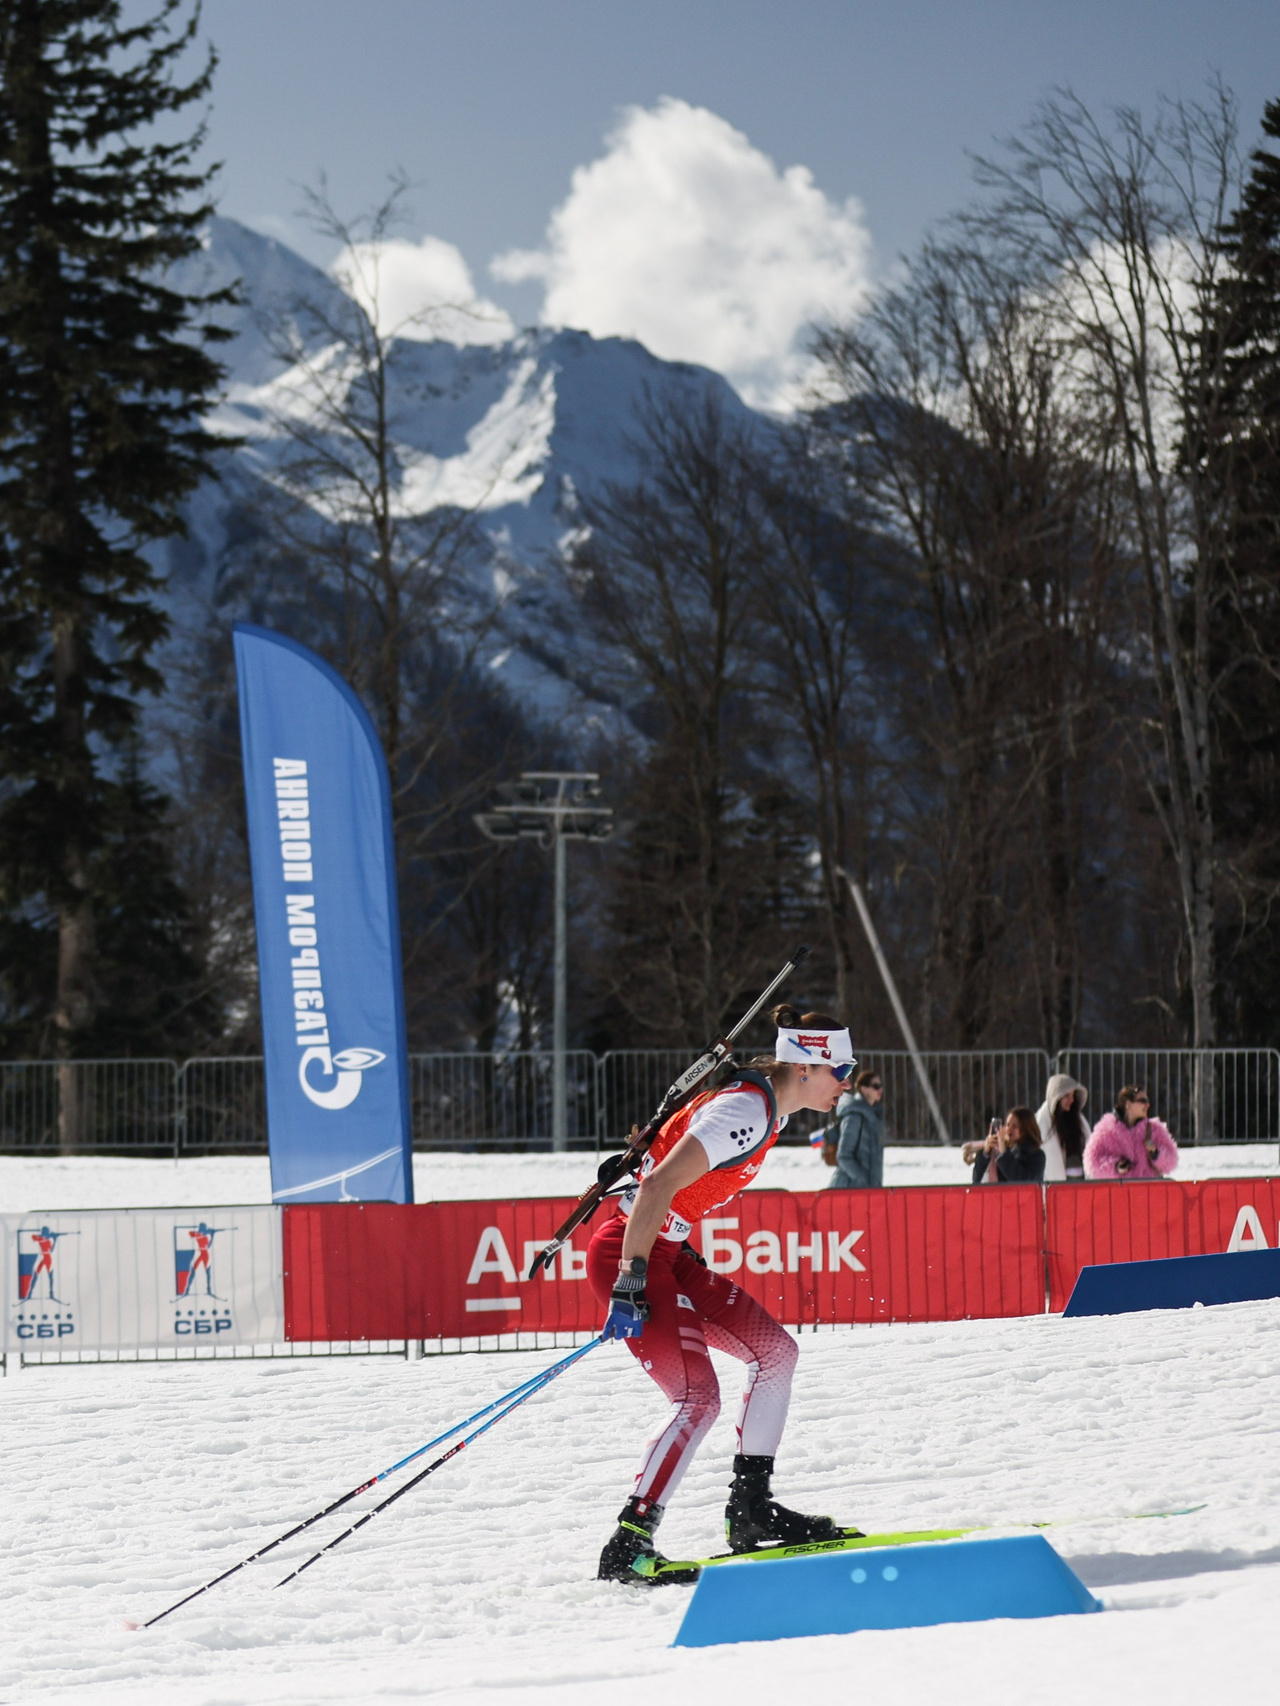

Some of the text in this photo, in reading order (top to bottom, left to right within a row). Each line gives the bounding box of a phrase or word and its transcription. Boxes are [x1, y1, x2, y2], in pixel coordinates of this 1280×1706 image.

[466, 1217, 867, 1285] Аль Банк
[16, 1323, 74, 1338] СБР
[174, 1318, 232, 1334] СБР
[783, 1540, 846, 1556] FISCHER
